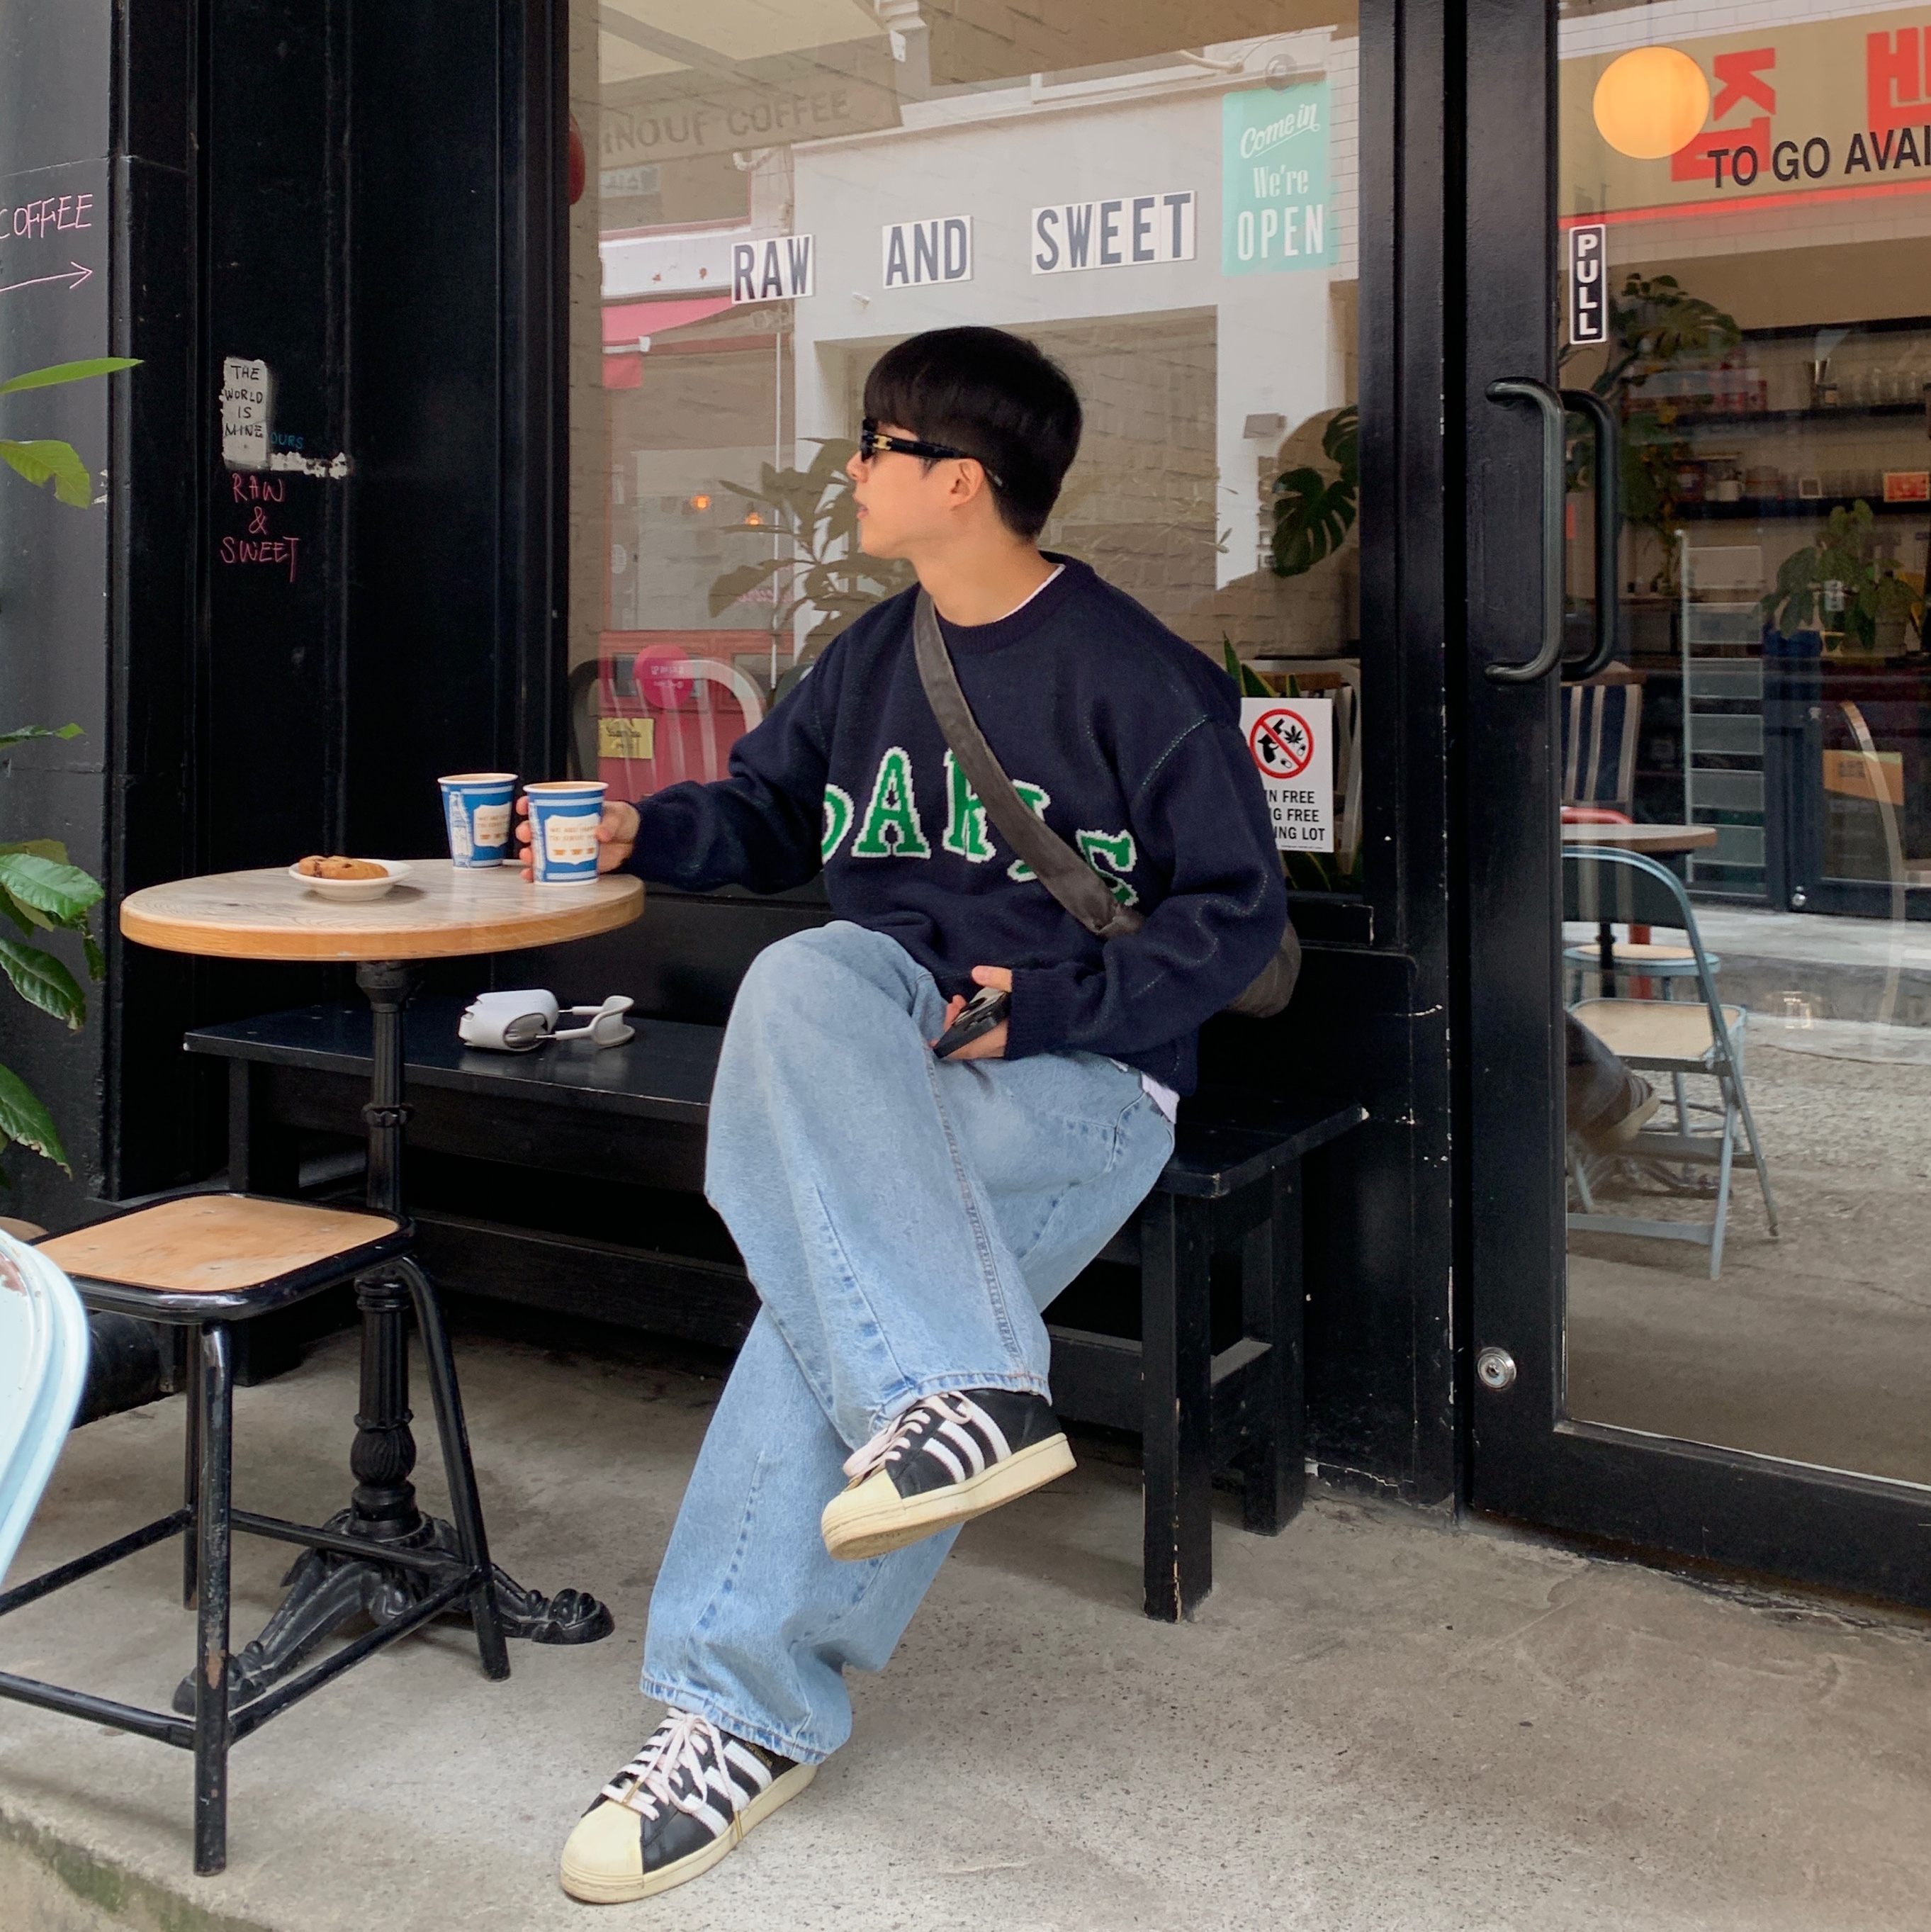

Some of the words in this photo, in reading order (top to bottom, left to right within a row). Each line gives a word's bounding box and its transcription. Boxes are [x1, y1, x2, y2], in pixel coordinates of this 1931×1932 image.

[726, 89, 850, 135] COFFEE
[1239, 113, 1294, 159] Come
[1296, 102, 1321, 133] in
[1707, 145, 1757, 189] TO
[1772, 137, 1830, 181] GO
[1252, 164, 1309, 199] We're
[0, 193, 94, 240] COFFEE
[1237, 203, 1325, 262] OPEN
[733, 235, 810, 302] RAW
[885, 218, 967, 287] AND
[1035, 193, 1191, 271] SWEET
[1577, 234, 1598, 336] PULL
[230, 365, 260, 381] THE
[224, 388, 264, 404] WORLD
[237, 406, 252, 419] IS
[224, 422, 264, 438] MINE
[270, 432, 305, 449] OURS
[232, 473, 284, 502] RAW
[249, 506, 267, 535] &
[220, 536, 300, 583] SWEET
[1283, 790, 1315, 804] FREE
[1287, 809, 1319, 822] FREE
[1302, 827, 1325, 841] LOT
